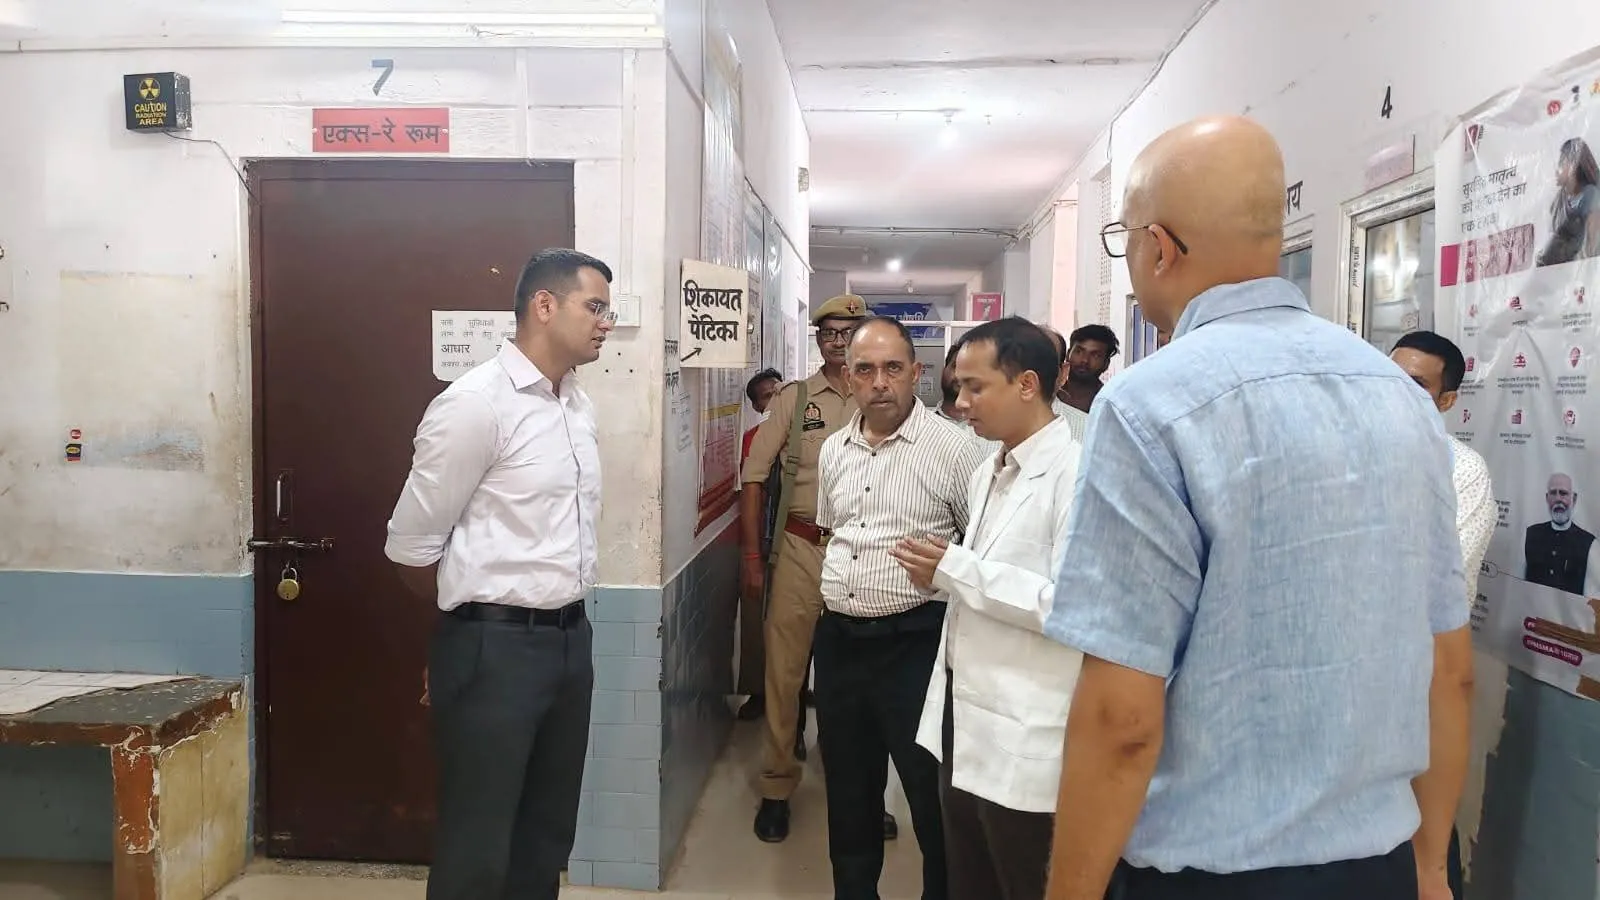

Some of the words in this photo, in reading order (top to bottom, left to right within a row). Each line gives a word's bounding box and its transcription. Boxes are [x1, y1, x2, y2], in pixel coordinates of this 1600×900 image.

[371, 59, 394, 96] 7
[134, 103, 167, 113] CAUTION
[1381, 85, 1393, 119] 4
[139, 118, 164, 126] AREA
[321, 117, 396, 144] एक्स-रे
[404, 124, 441, 144] रूम
[683, 279, 743, 315] शिकायत
[688, 314, 739, 341] पेटिका
